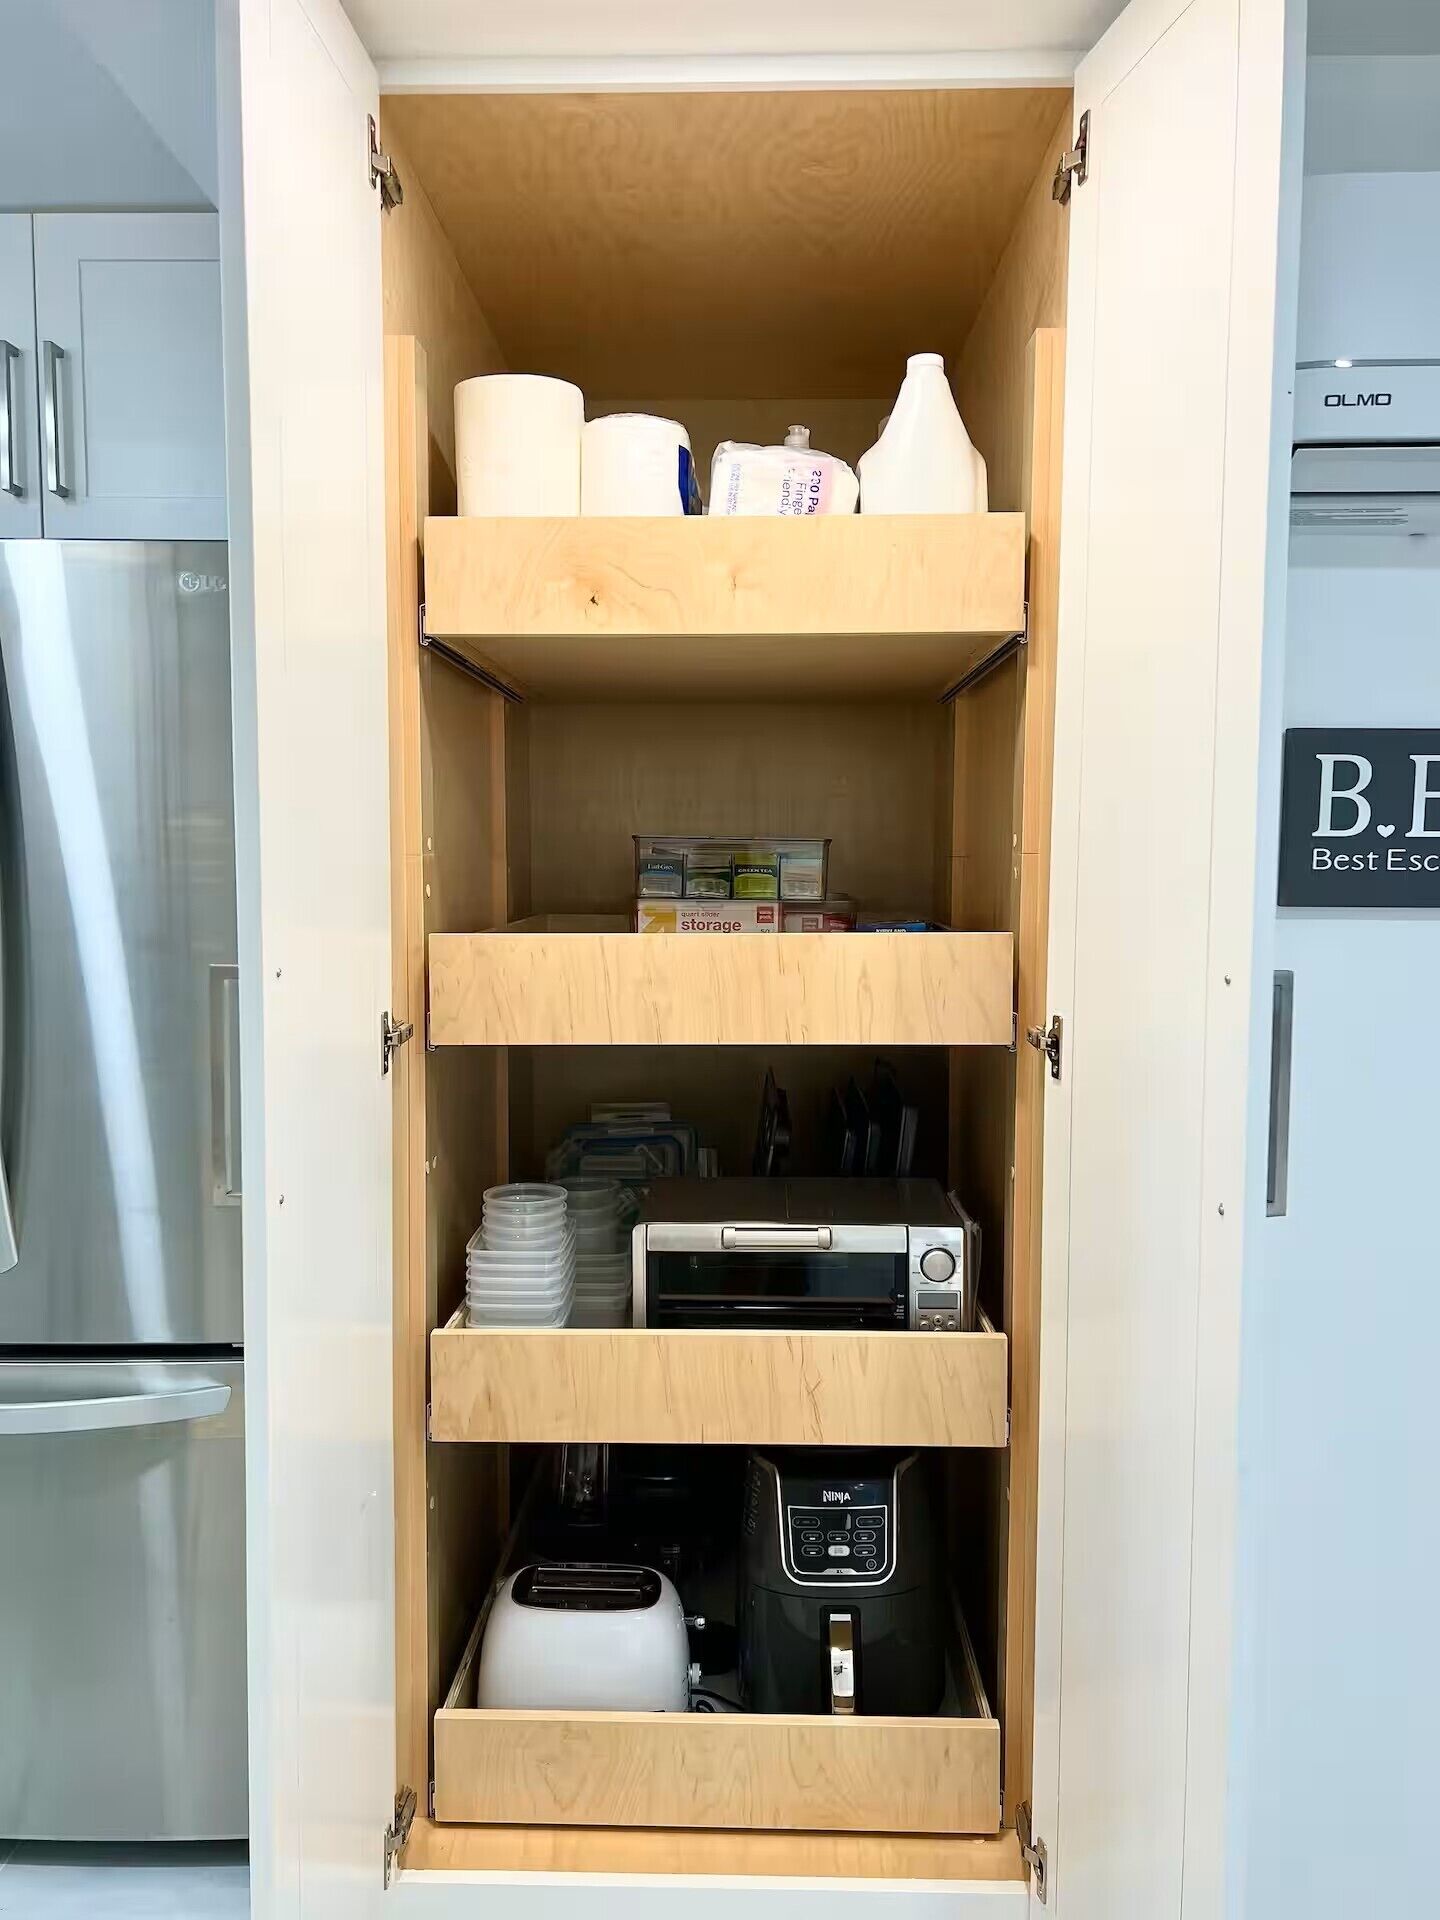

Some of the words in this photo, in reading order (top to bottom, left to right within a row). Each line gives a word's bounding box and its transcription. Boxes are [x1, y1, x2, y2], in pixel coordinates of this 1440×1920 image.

[1324, 393, 1392, 407] OLMO
[804, 497, 819, 516] Pa
[1312, 848, 1379, 871] Best
[681, 919, 742, 933] storage
[822, 1490, 851, 1504] NINJA
